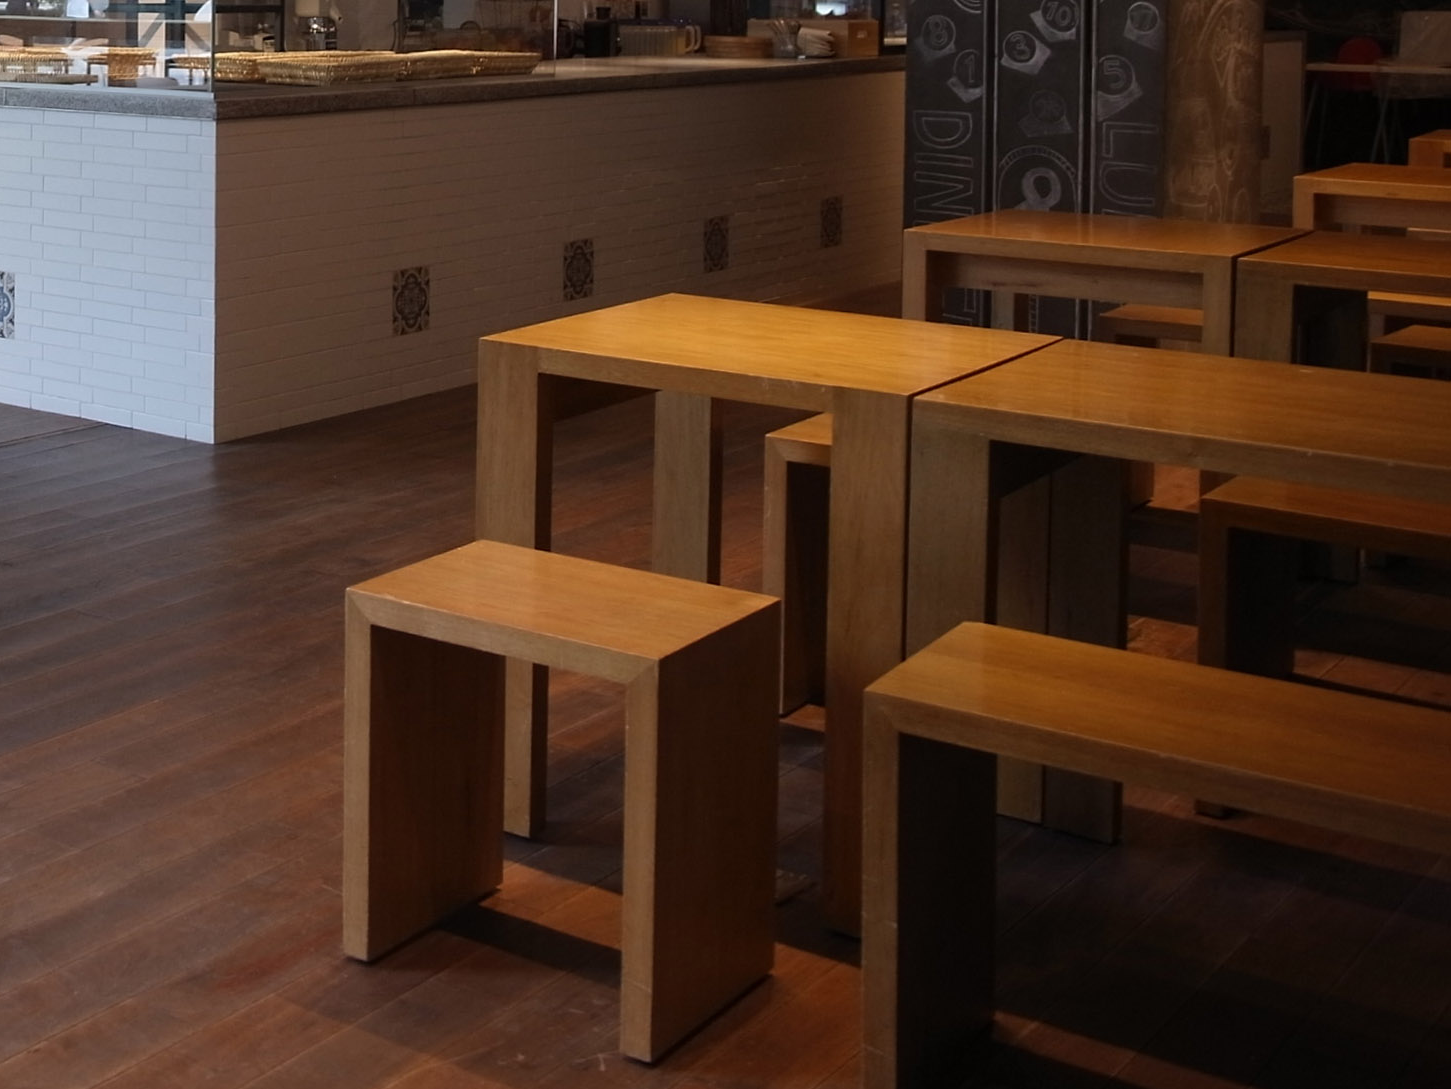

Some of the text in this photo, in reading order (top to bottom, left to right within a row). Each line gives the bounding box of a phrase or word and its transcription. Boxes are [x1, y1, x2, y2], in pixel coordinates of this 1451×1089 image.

[1045, 1, 1072, 28] 10
[928, 17, 948, 47] 8
[1010, 34, 1030, 58] 3
[962, 54, 976, 83] 1
[1101, 59, 1124, 89] 5
